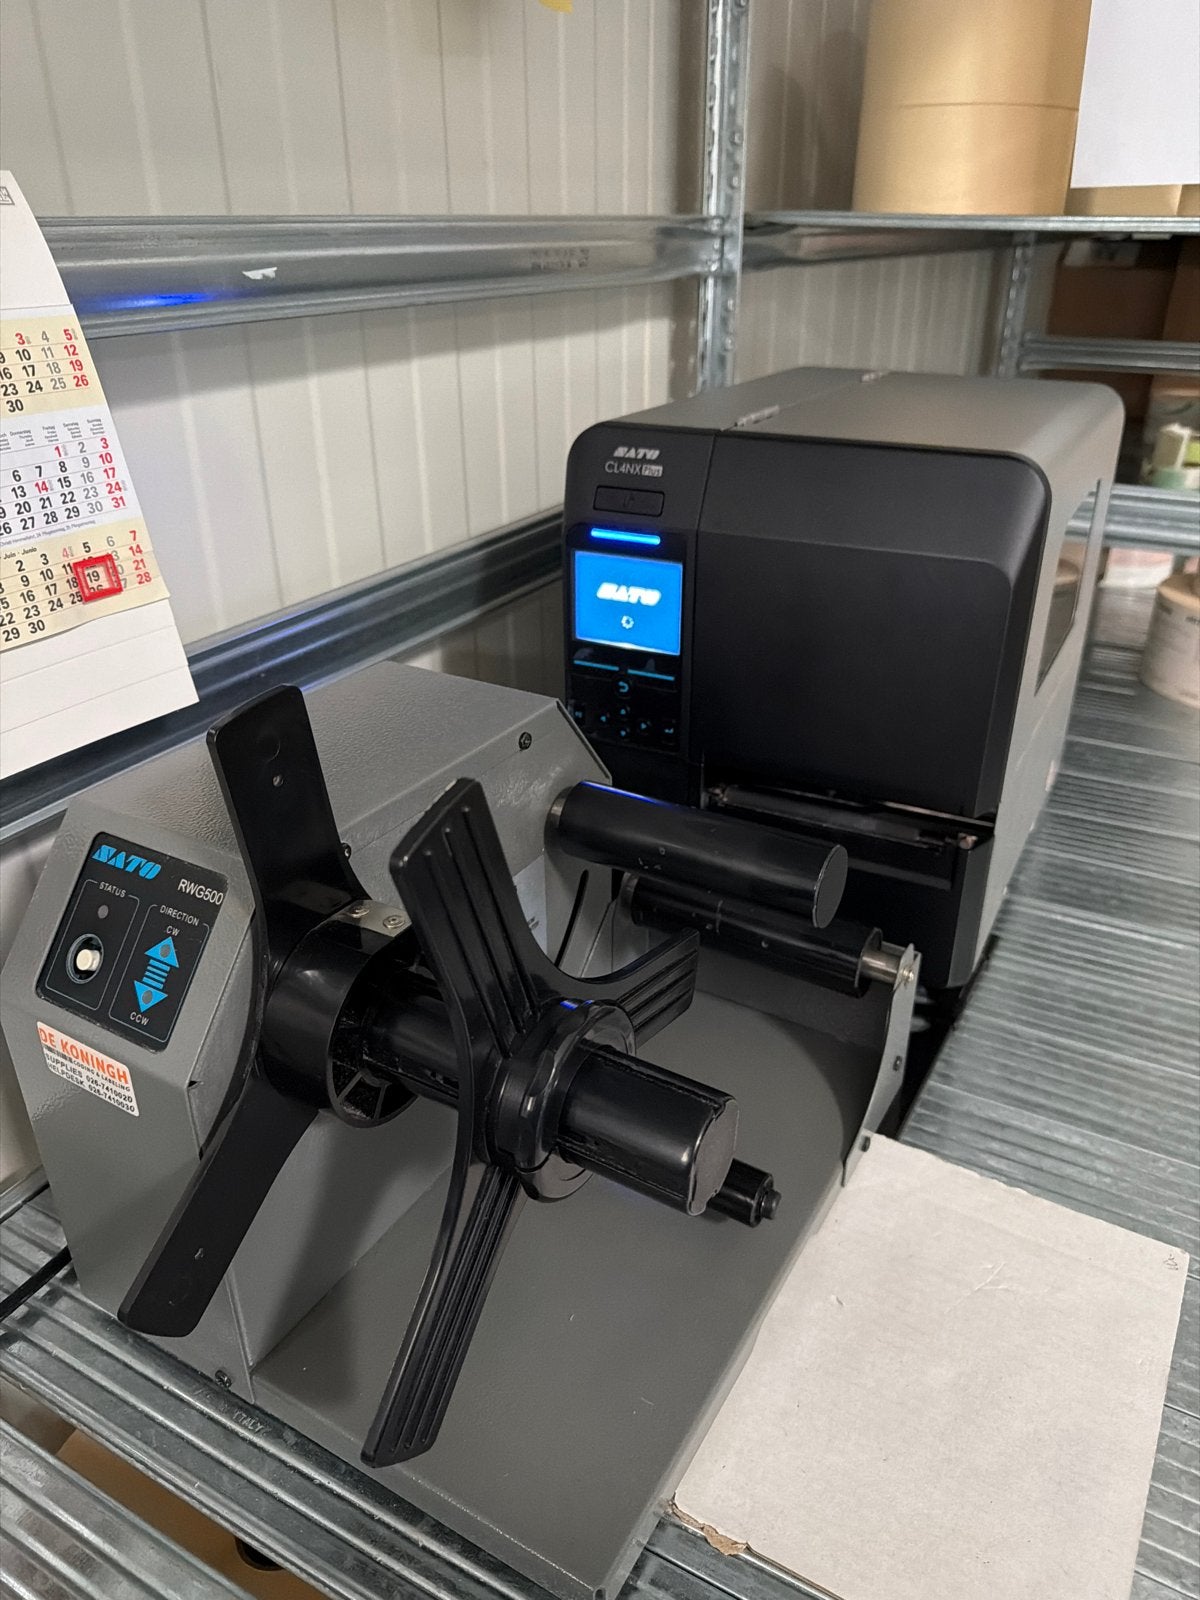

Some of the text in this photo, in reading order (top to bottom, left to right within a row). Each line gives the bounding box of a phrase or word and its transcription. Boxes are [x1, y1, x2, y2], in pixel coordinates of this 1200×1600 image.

[15, 328, 73, 345] 3 4 5
[15, 348, 32, 361] 10
[41, 346, 55, 359] 11
[63, 344, 79, 357] 12
[22, 364, 36, 377] 17
[46, 361, 62, 375] 18
[69, 359, 84, 372] 19
[1, 374, 89, 397] 23 24 25 26
[6, 399, 24, 413] 30
[54, 437, 109, 458] 1 2 3
[613, 446, 660, 460] SATO
[12, 452, 113, 482] 6 7 8 9 10
[604, 461, 641, 475] CL4NX
[11, 466, 116, 499] 13 14 15 16 17
[0, 481, 122, 520] 9 20 21 22 23 24
[20, 516, 36, 530] 27
[43, 511, 59, 525] 28
[64, 506, 80, 520] 29
[87, 501, 104, 514] 30
[111, 496, 126, 509] 31
[15, 530, 137, 572] 2 3 4 5 6 7
[20, 575, 30, 587] 9
[40, 568, 54, 582] 10
[62, 562, 74, 575] 11
[129, 544, 144, 557] 14
[20, 589, 36, 603] 16
[45, 583, 58, 596] 17
[66, 576, 79, 590] 18
[86, 570, 101, 583] 19
[132, 558, 147, 571] 21
[0, 612, 16, 627] 22
[23, 604, 41, 619] 23
[48, 598, 64, 612] 24
[69, 591, 83, 605] 25
[136, 571, 152, 585] 28
[597, 582, 662, 606] SATO
[2, 619, 46, 642] 29 30
[91, 844, 162, 880] SATO
[99, 881, 127, 898] STATUS
[177, 878, 224, 905] RWG500
[159, 904, 200, 926] DIRECTION
[166, 925, 180, 936] CW
[129, 1011, 150, 1026] CCW
[38, 1028, 129, 1085] DE KONINGH
[45, 1053, 83, 1078] SUPPLIES
[47, 1061, 85, 1088] HELPDESK
